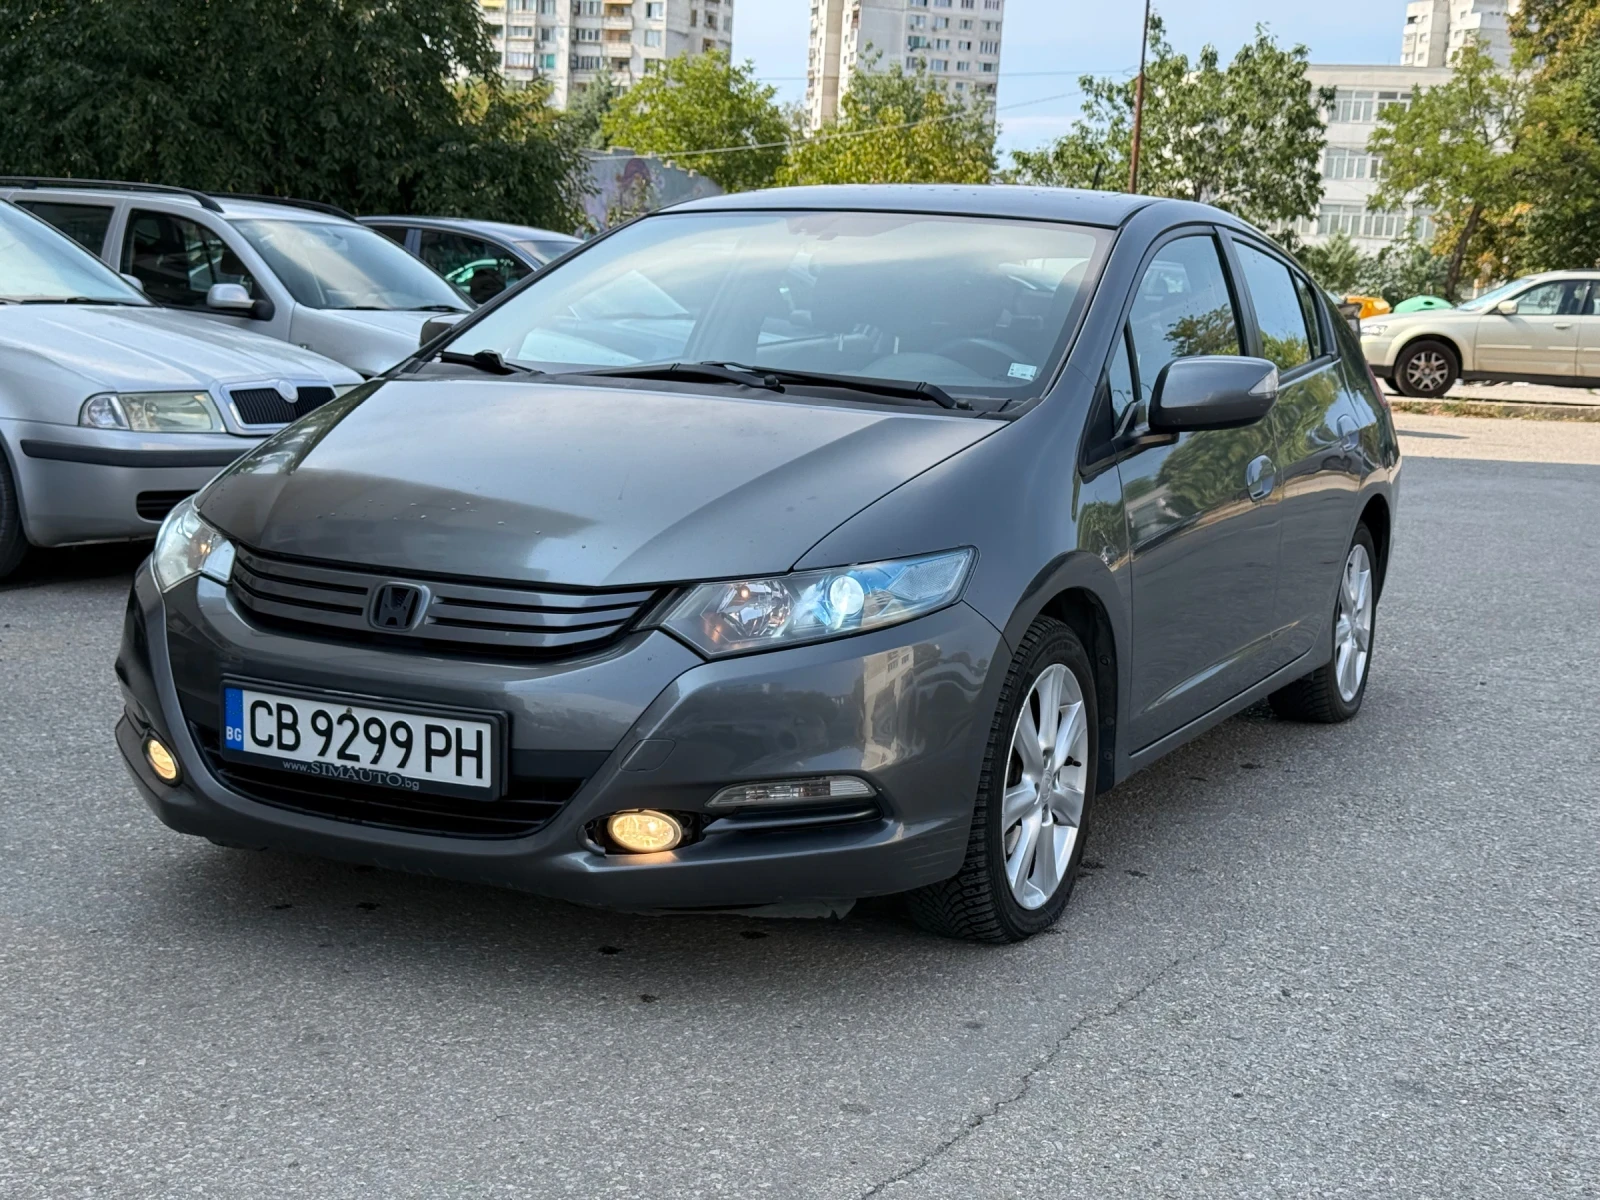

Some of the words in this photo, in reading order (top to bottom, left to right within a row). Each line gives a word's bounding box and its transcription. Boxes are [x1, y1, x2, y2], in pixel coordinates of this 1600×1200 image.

[226, 726, 242, 742] BG
[250, 700, 301, 752] CB
[310, 709, 413, 769] 9299
[424, 724, 484, 779] PH
